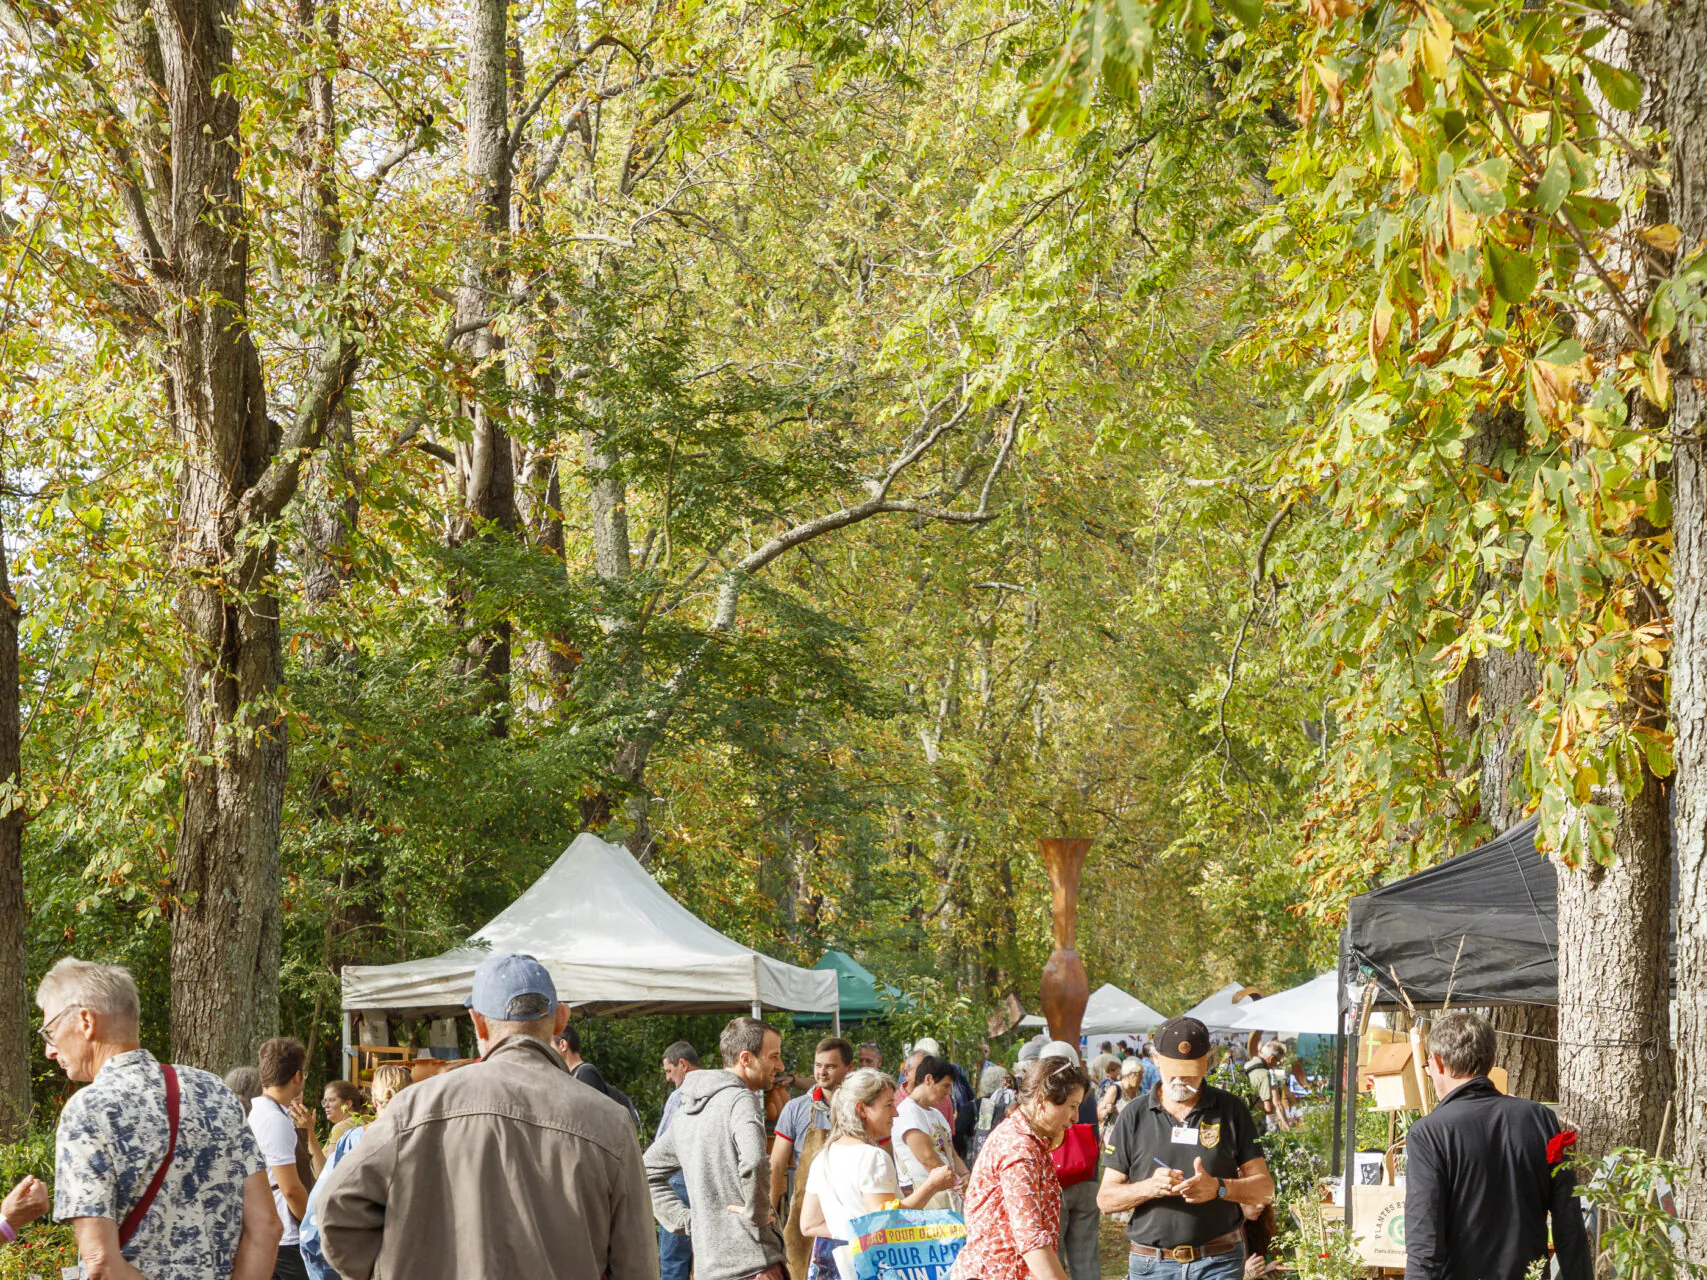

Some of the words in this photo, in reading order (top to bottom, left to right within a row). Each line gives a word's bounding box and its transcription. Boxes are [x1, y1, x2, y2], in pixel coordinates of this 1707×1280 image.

[1374, 1202, 1395, 1240] PLANTES
[888, 1228, 915, 1241] POUR
[876, 1246, 922, 1266] POUR
[929, 1240, 966, 1263] APP
